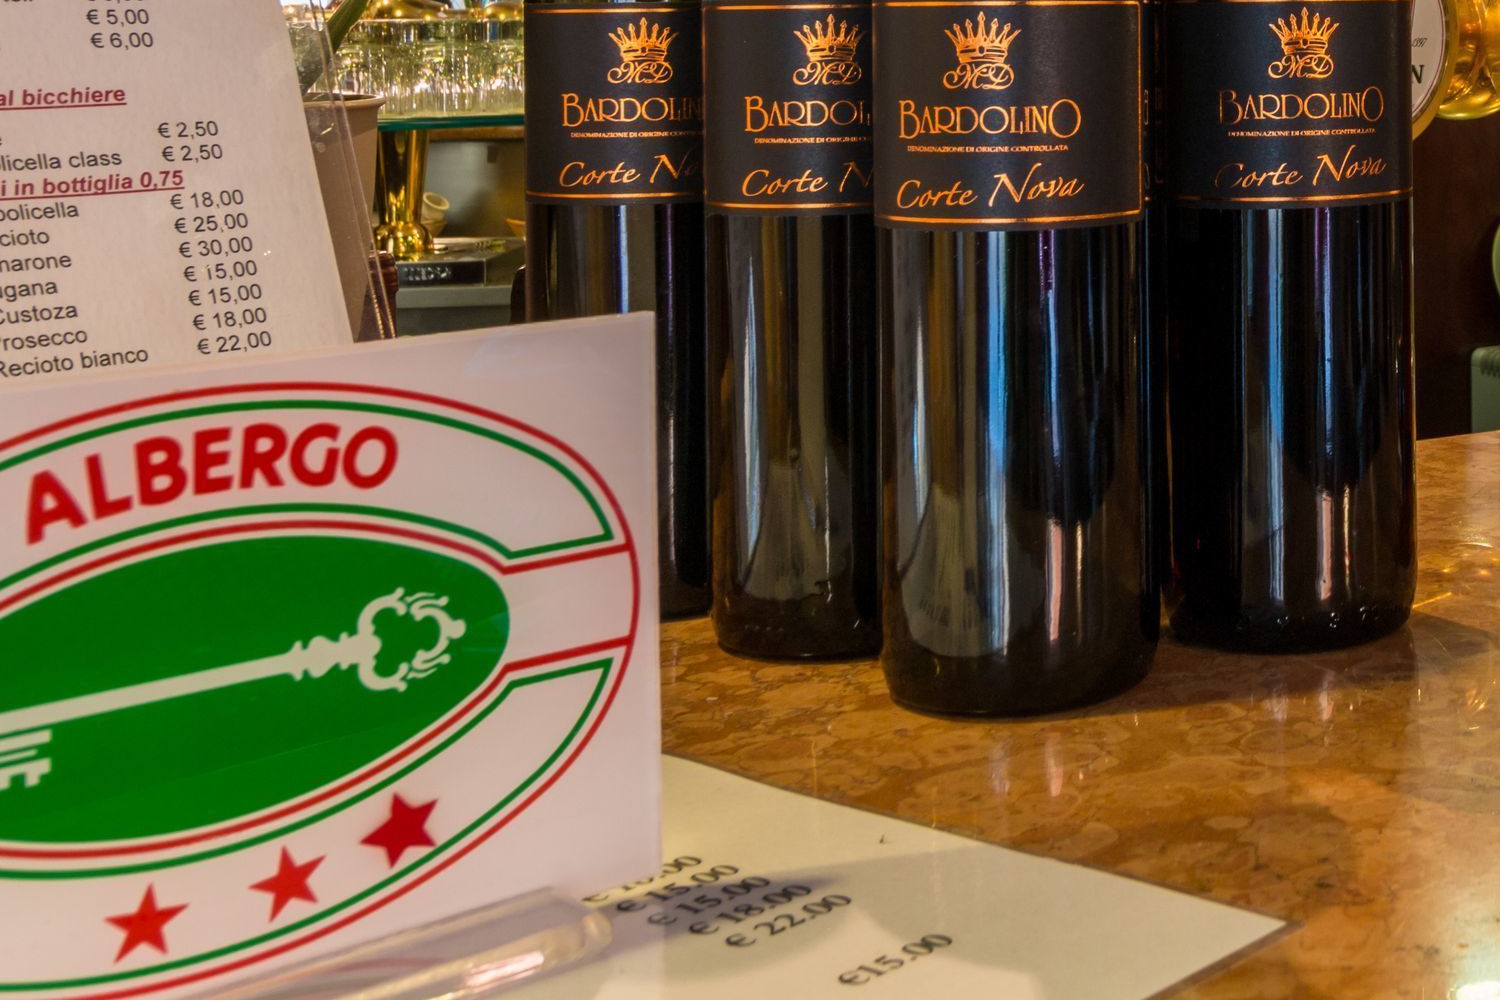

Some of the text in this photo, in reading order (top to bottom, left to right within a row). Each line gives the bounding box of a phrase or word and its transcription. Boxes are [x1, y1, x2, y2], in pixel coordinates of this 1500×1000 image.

[86, 8, 149, 27] € 5,00
[90, 32, 154, 51] € 6,00
[22, 86, 126, 106] bicchiere
[1219, 85, 1385, 127] BARDOLINO
[157, 120, 219, 139] € 2,50
[899, 98, 1082, 140] BARDOLINO
[69, 151, 123, 169] class
[162, 145, 176, 162] €
[181, 143, 223, 164] 2,50
[1214, 144, 1387, 189] Corte Nova
[15, 179, 34, 196] in
[43, 172, 133, 195] bottiglia
[140, 169, 184, 190] 0,75
[559, 161, 641, 188] Corte
[742, 168, 828, 197] Corte
[896, 162, 1085, 209] Corte Nova
[170, 193, 184, 210] €
[190, 188, 245, 209] 18,00
[174, 217, 188, 234] €
[193, 212, 249, 233] 25,00
[179, 241, 193, 258] €
[198, 235, 254, 257] 30,00
[183, 265, 198, 282] €
[188, 289, 202, 306] €
[207, 283, 262, 305] 15,00
[193, 313, 207, 331] €
[213, 307, 268, 329] 18,00
[80, 348, 149, 370] bianco
[197, 338, 212, 355] €
[216, 330, 272, 353] 22,00
[26, 422, 399, 547] ALBERGO
[647, 864, 739, 901] 15.00
[676, 875, 771, 915] 15.00
[688, 883, 813, 936] € 18.00
[725, 893, 852, 948] € 22.00
[837, 933, 953, 987] €15.00
